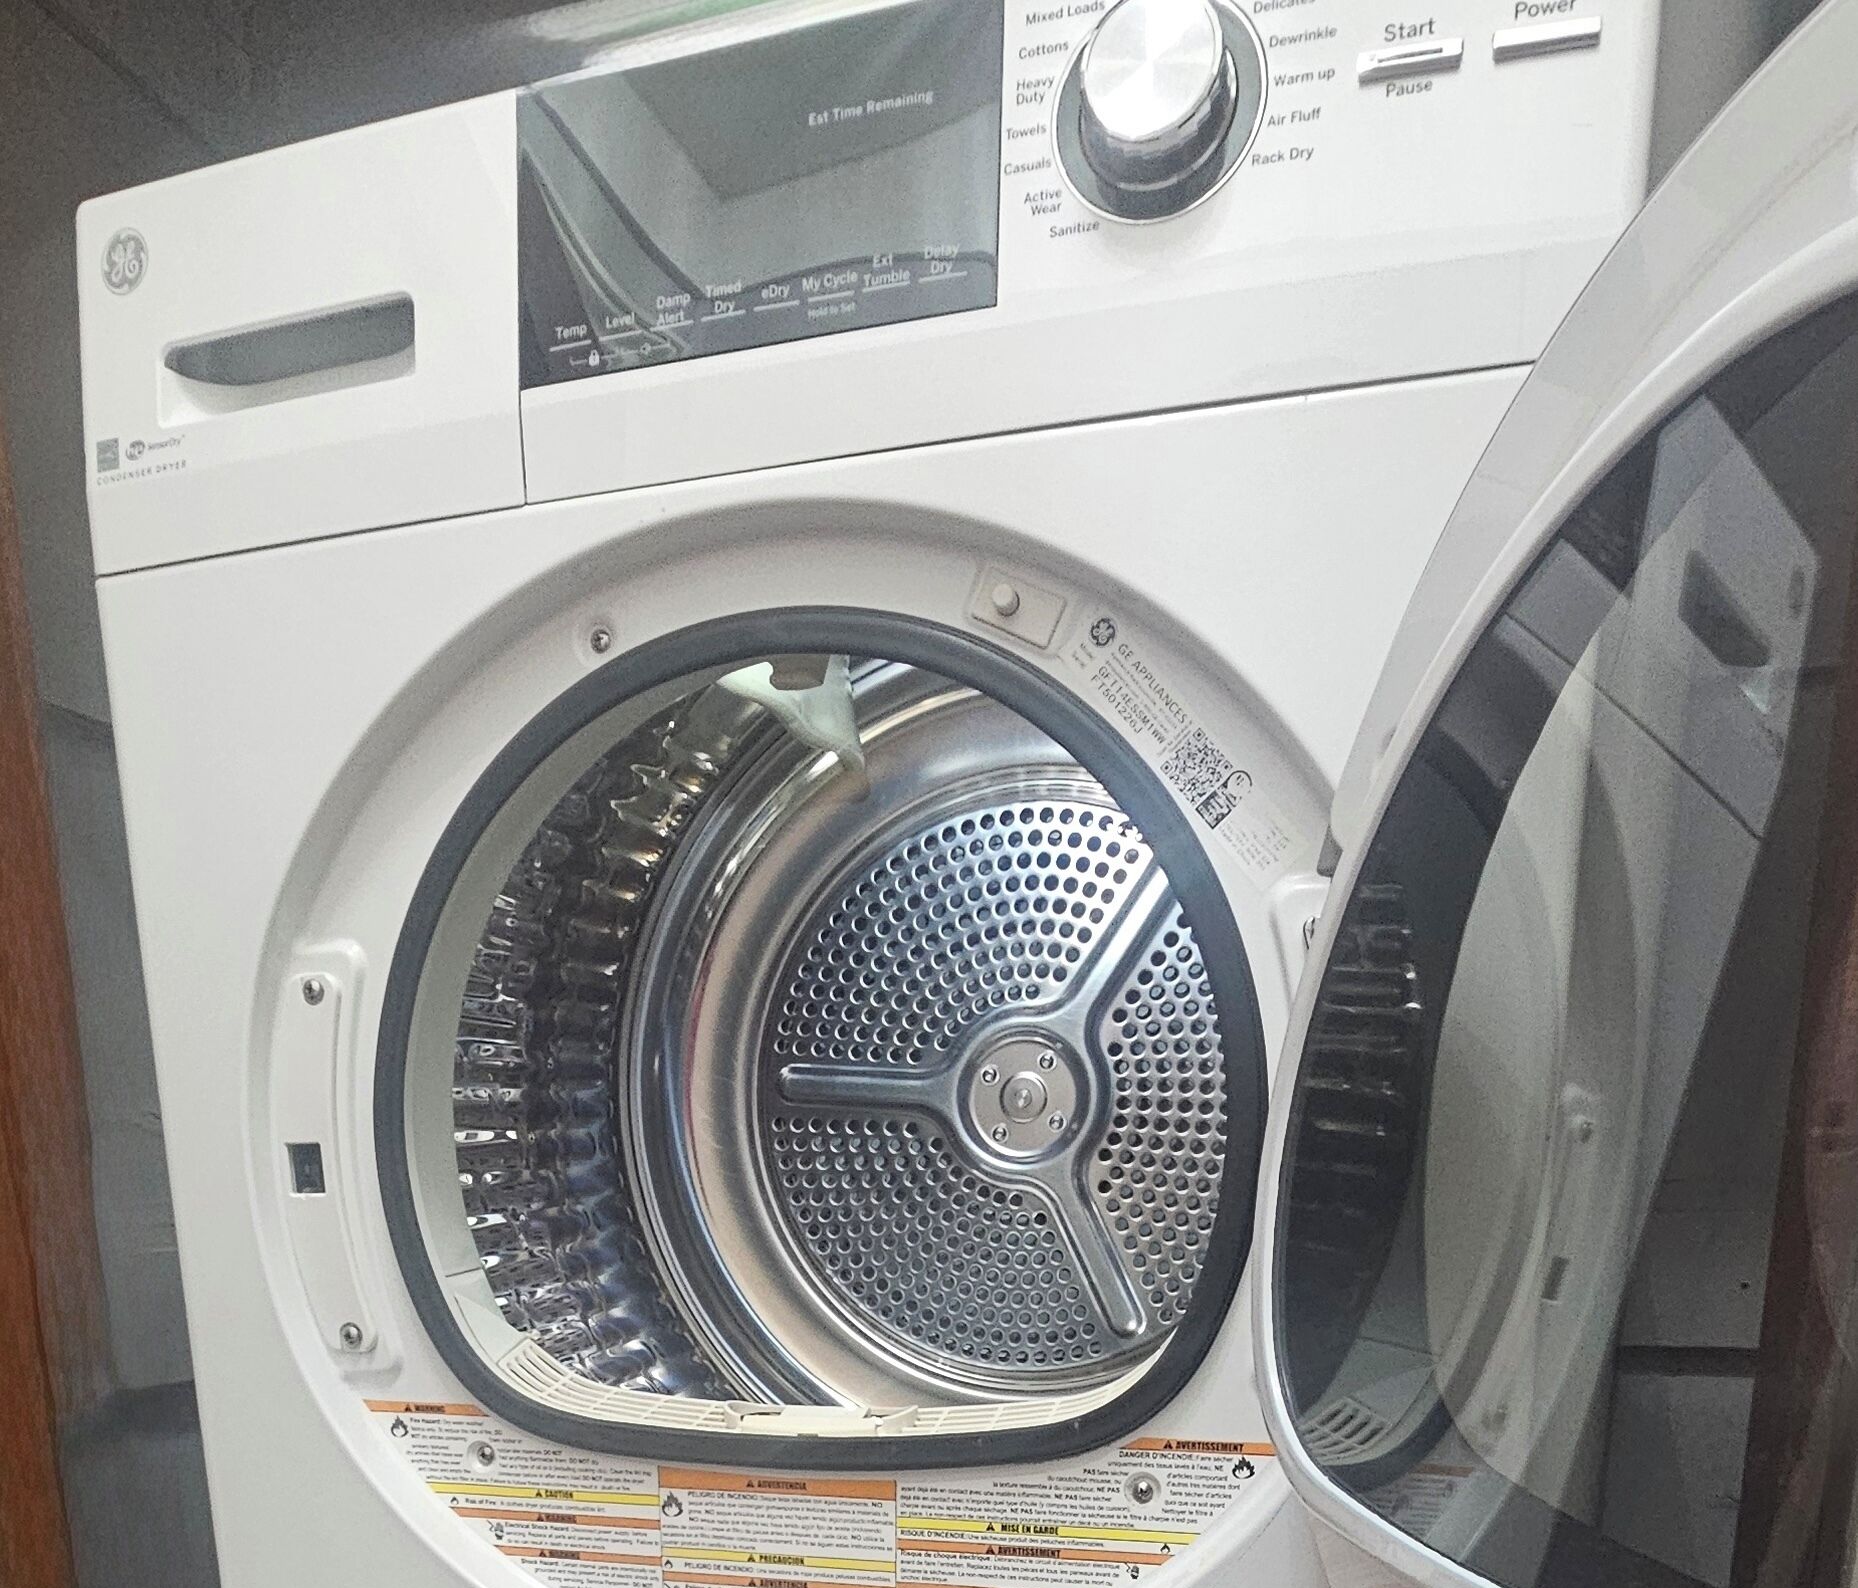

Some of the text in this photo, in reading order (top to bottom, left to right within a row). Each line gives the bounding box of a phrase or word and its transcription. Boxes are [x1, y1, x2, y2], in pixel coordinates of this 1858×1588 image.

[1026, 2, 1105, 26] Mixed Loads
[1514, 0, 1576, 20] Power
[1269, 26, 1337, 48] Dewrinkle
[1384, 18, 1436, 42] Start
[1019, 40, 1069, 60] Cottons
[1016, 76, 1055, 91] Heavy
[1274, 68, 1335, 86] Warm up
[1386, 80, 1433, 97] Pause
[1016, 92, 1045, 106] Duty
[808, 91, 934, 126] Est Time Remaining
[1267, 107, 1321, 127] Air Fluff
[1006, 124, 1047, 140] Towels
[1252, 147, 1314, 166] Rack Dry
[1004, 157, 1052, 175] Casuals
[1024, 189, 1062, 204] Active
[1031, 202, 1062, 216] Wear
[1050, 221, 1100, 238] Sanitize
[924, 244, 960, 260] Delay
[873, 254, 892, 268] Ext
[930, 260, 952, 275] Dry
[802, 270, 858, 292] My Cycle
[863, 269, 910, 287] Tumble
[705, 280, 741, 298] Timed
[761, 285, 790, 299] eDry
[656, 293, 691, 310] Damp
[714, 300, 736, 314] Dry
[606, 312, 635, 328] Level
[657, 310, 684, 326] Alert
[555, 324, 587, 340] Temp
[1118, 644, 1134, 659] GE
[1132, 661, 1187, 724] APPLIANCES
[1119, 1451, 1150, 1459] DANGER
[1176, 1441, 1244, 1453] AVERTISSEMENT
